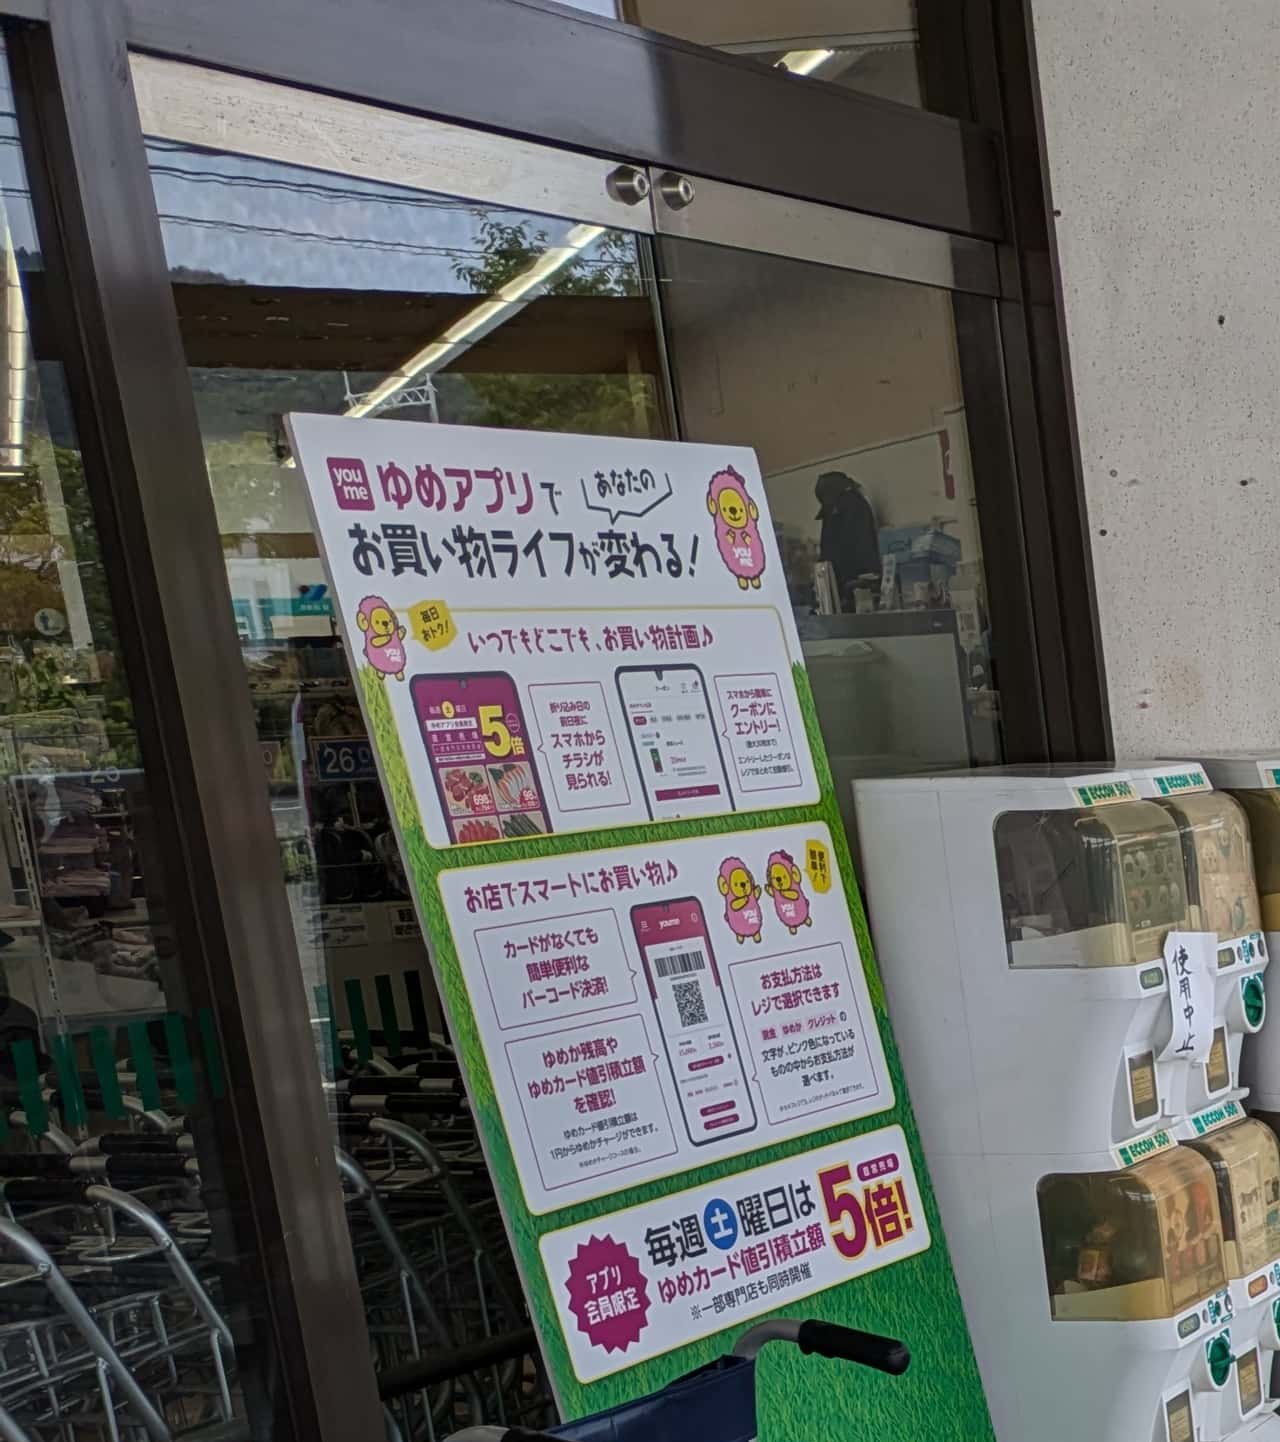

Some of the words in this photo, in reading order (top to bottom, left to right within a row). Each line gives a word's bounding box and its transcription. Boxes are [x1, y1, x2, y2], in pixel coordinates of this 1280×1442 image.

[333, 467, 363, 487] you
[594, 468, 656, 498] あなたの
[343, 485, 369, 501] me
[420, 606, 440, 624] 毎日
[731, 702, 777, 718] クーポンに
[551, 730, 606, 749] スマホから
[562, 750, 604, 769] チラシが
[504, 927, 600, 959] カードがなくても
[526, 955, 590, 984] 簡単便利な
[760, 963, 823, 990] お支払方法は
[751, 982, 841, 1017] レジで選択できます
[1172, 944, 1196, 1053] 使用中止
[807, 1013, 837, 1030] クレジット
[839, 1011, 848, 1022] の
[542, 1036, 619, 1069] ゆめか残高や
[527, 1055, 647, 1100] ゆめカード値引積立額
[644, 1180, 817, 1269] 毎週土曜日は
[657, 1222, 827, 1304] ゆめカード値引積立額
[586, 1265, 622, 1295] アプリ
[584, 1286, 641, 1327] 会員限定
